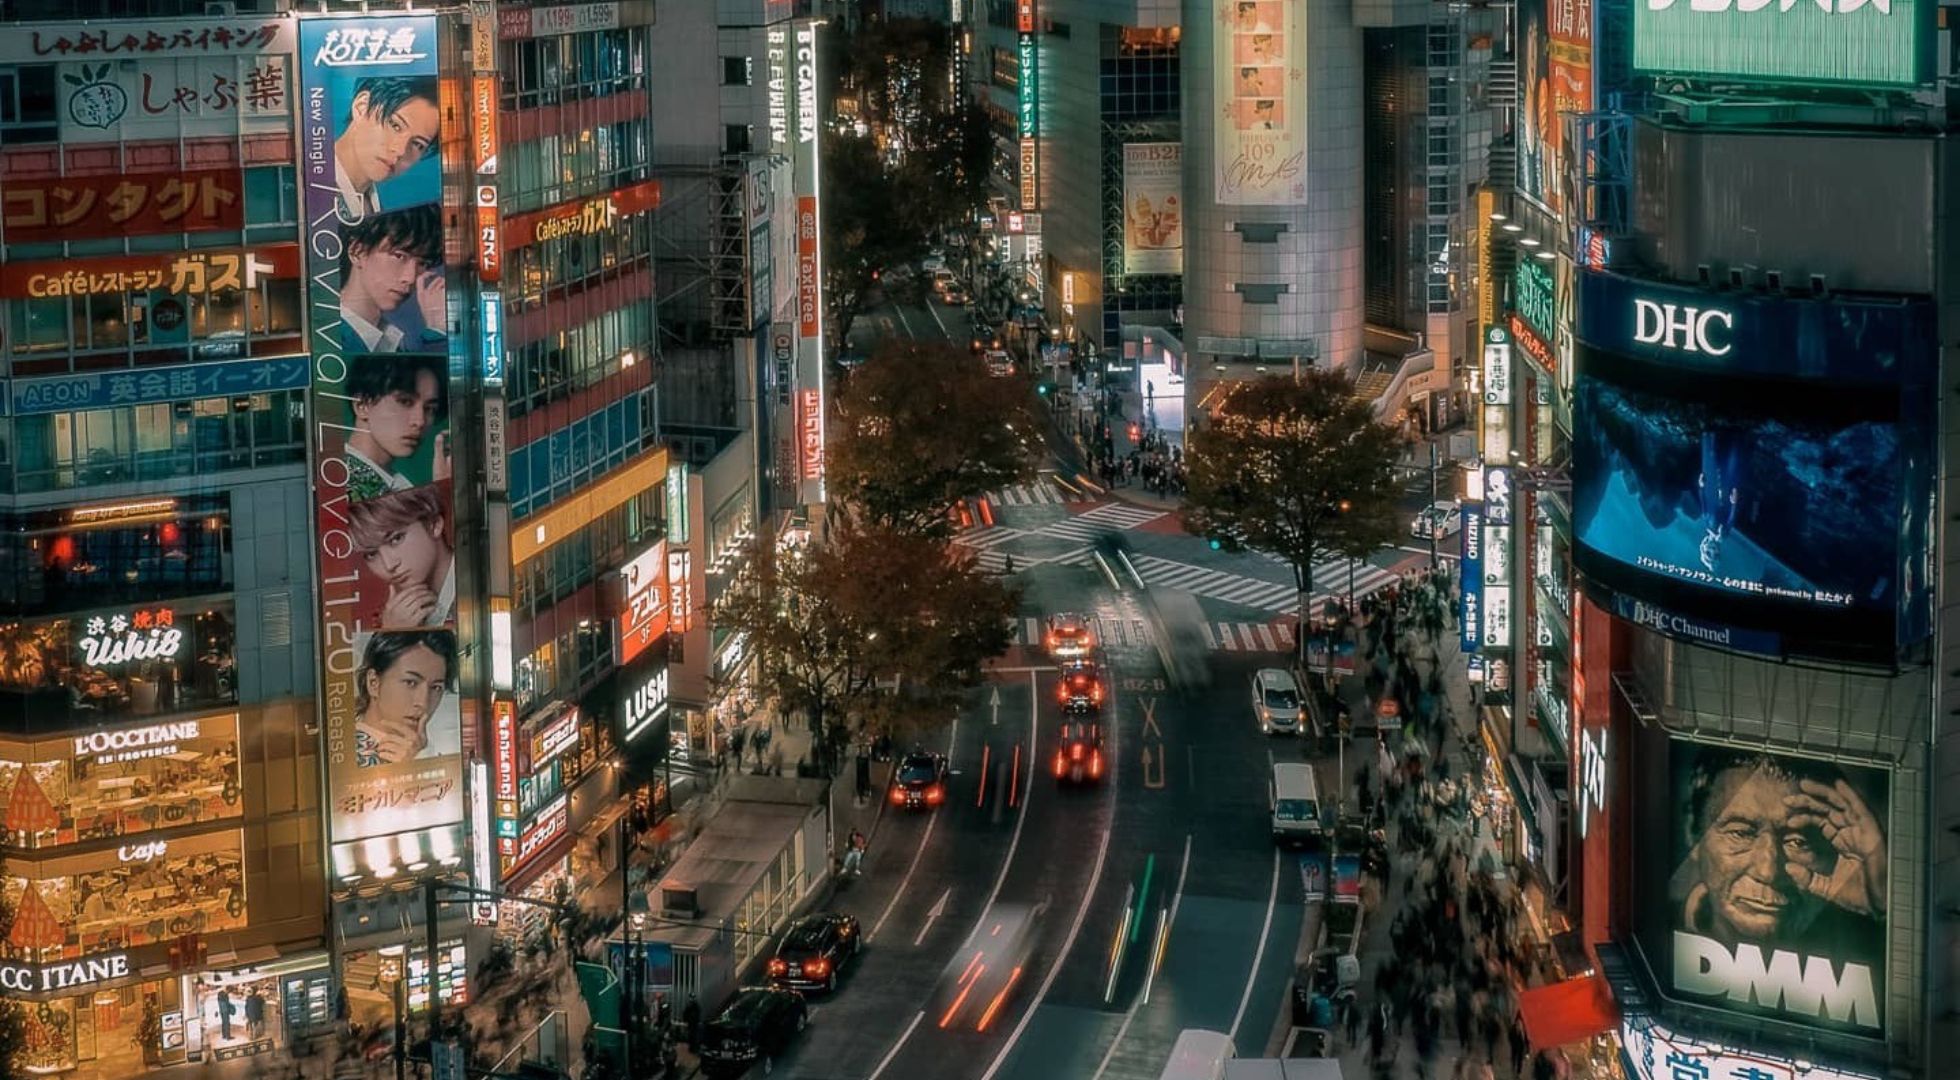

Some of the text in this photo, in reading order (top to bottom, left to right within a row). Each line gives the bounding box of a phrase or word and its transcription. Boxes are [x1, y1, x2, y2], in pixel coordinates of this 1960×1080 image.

[33, 24, 280, 55] しゃぶしゃぶバイキング
[142, 65, 285, 113] しゃぶ葉
[309, 87, 326, 174] New Single
[1022, 141, 1035, 208] HOOTERS
[5, 176, 235, 228] コンタクト
[582, 198, 618, 236] ガスト
[481, 226, 498, 271] ガスト
[171, 253, 275, 294] ガスト
[486, 302, 500, 377] イーオン
[1634, 299, 1732, 356] DHC
[25, 363, 305, 402] AEON 英会話イーオン
[489, 406, 501, 483] 渋谷駅前ビル
[1468, 513, 1479, 560] MIZUHO
[87, 608, 174, 636] 渋谷 焼肉
[324, 569, 362, 675] 11.20
[1671, 616, 1731, 644] Channel
[625, 667, 668, 729] LUSH
[75, 721, 200, 756] L'OCCITANE
[328, 680, 346, 764] Release
[117, 744, 178, 762] PROVENCE
[118, 840, 167, 863] Café
[1673, 930, 1881, 1029] DMM
